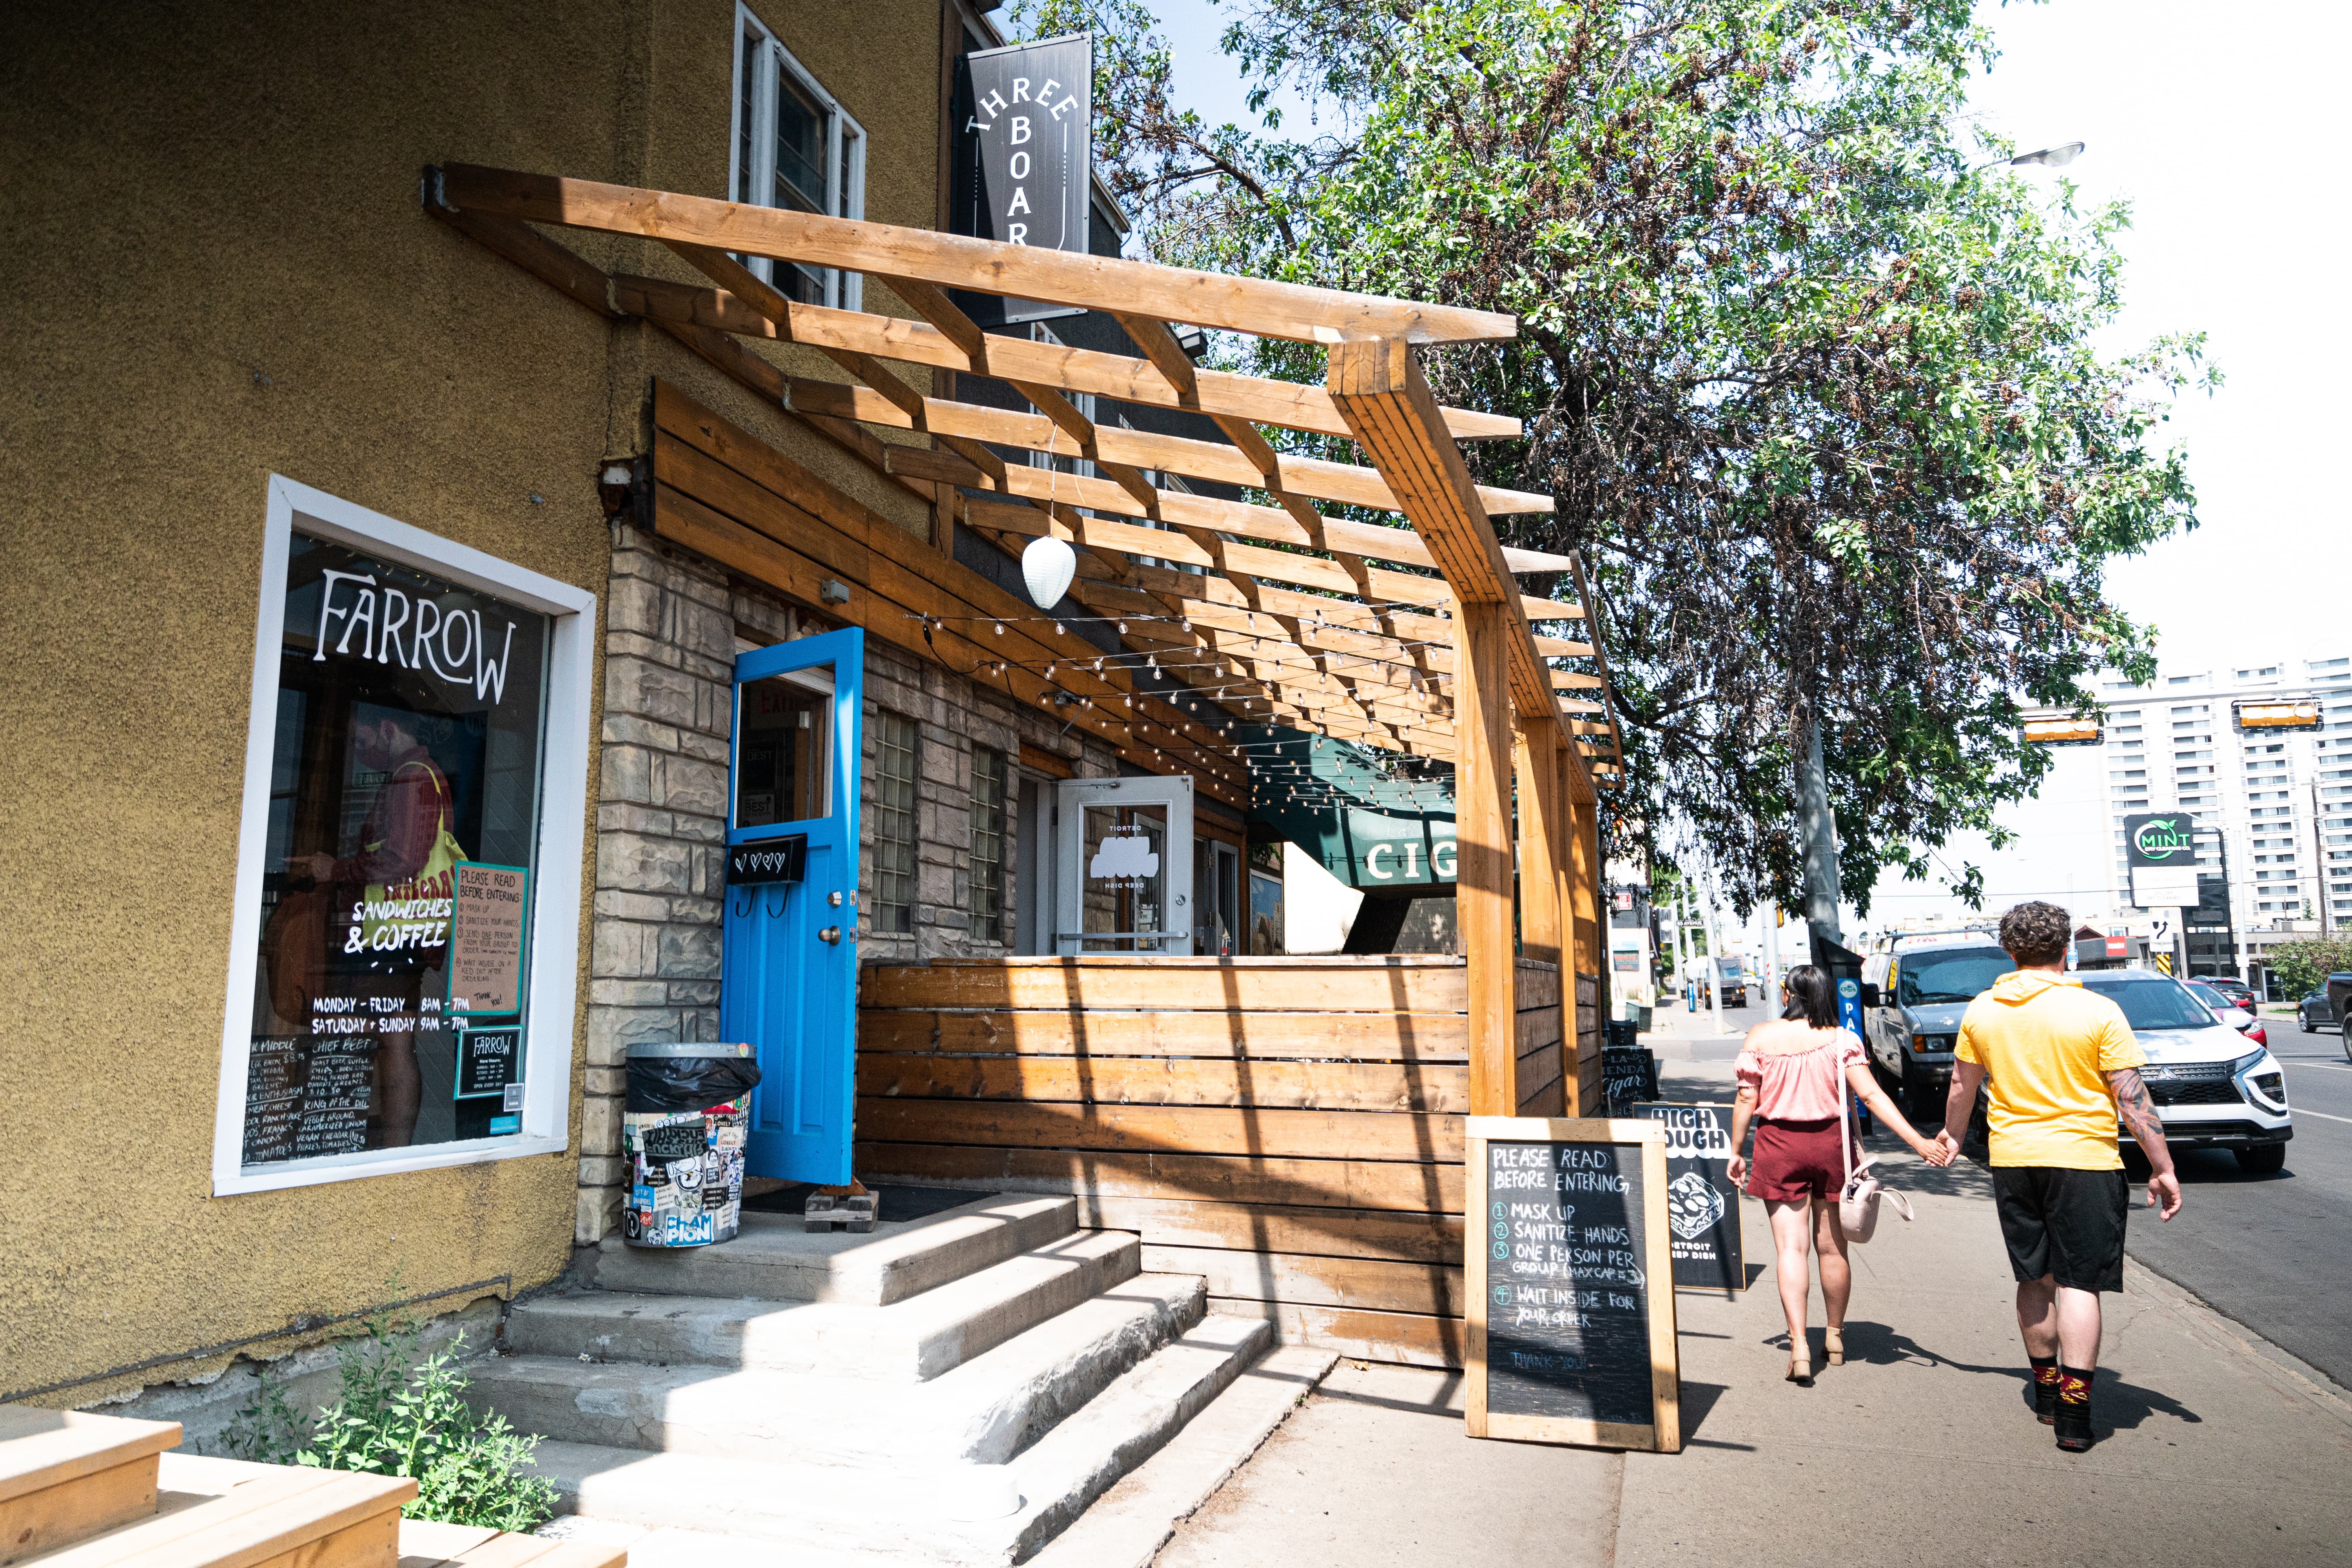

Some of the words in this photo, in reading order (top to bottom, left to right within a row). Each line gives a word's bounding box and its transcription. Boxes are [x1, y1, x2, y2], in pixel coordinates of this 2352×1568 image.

[966, 78, 1079, 134] THREE
[313, 568, 516, 705] FARROW
[745, 801, 771, 811] BEST
[2141, 834, 2190, 847] MINT
[1367, 842, 1457, 879] CIG
[461, 870, 488, 886] PLEASE
[495, 874, 515, 887] READ
[460, 885, 483, 900] BEFORE
[487, 889, 522, 902] ENTERING:
[352, 898, 453, 921] SANDWICHES
[466, 904, 480, 912] MASK
[466, 916, 488, 925] SANITIZE
[491, 917, 501, 925] YOUR
[344, 926, 369, 953] &
[373, 921, 447, 951] COFFEE
[466, 929, 479, 938] SEND
[474, 992, 491, 1001] THANK
[491, 993, 502, 1007] YOU!
[313, 997, 357, 1013] MONDAY
[370, 998, 405, 1013] FRIDAY
[421, 998, 441, 1012] 8AM
[453, 998, 470, 1011] 7PM
[312, 1018, 366, 1034] SATURDAY
[379, 1018, 416, 1033] SUNDAY
[420, 1017, 440, 1031] 9AM
[452, 1017, 469, 1030] 7PM
[261, 1038, 296, 1052] MIDDLE
[313, 1040, 339, 1053] CHIEF
[343, 1037, 371, 1051] BEEF
[474, 1035, 511, 1057] FARROW
[260, 1066, 284, 1076] CHEDDAR
[312, 1066, 332, 1074] CHIPS
[1602, 1065, 1646, 1074] IENDA
[252, 1082, 282, 1091] GREENS!
[260, 1086, 303, 1099] ENTHUSIASM
[1602, 1075, 1647, 1098] Cigar
[269, 1102, 292, 1111] CHEESE
[304, 1100, 326, 1111] KING
[329, 1098, 338, 1107] OF
[337, 1097, 350, 1106] THE
[355, 1099, 369, 1108] DILL
[262, 1113, 285, 1124] RANCH
[304, 1113, 325, 1125] VEGGIE
[345, 1120, 367, 1129] ONIONS
[657, 1116, 686, 1128] GOOD
[1652, 1109, 1712, 1129] HIGH
[252, 1133, 282, 1146] ONIONS
[296, 1132, 320, 1142] VEGAN
[322, 1131, 348, 1140] CHEDDAR
[1665, 1130, 1725, 1149] OUGH
[1493, 1149, 1549, 1168] PLEASE
[1561, 1149, 1607, 1169] READ
[1494, 1170, 1547, 1190] BEFORE
[1511, 1203, 1552, 1222] MASK
[1557, 1205, 1575, 1221] UP
[1514, 1221, 1577, 1241] SANITIZE
[1585, 1227, 1630, 1245] HANDS
[1516, 1243, 1544, 1261] ONE
[1550, 1244, 1601, 1265] PERSON
[1608, 1250, 1634, 1268] PER
[1671, 1250, 1689, 1259] EEP
[1692, 1252, 1716, 1260] DISH
[1512, 1261, 1558, 1277] GROUP
[1517, 1284, 1549, 1305] WAIT
[1554, 1289, 1602, 1308] INSIDE
[1609, 1292, 1635, 1311] FOR
[1516, 1306, 1549, 1327] YOUR
[1552, 1310, 1591, 1328] ORDER
[1511, 1352, 1553, 1368] THANK
